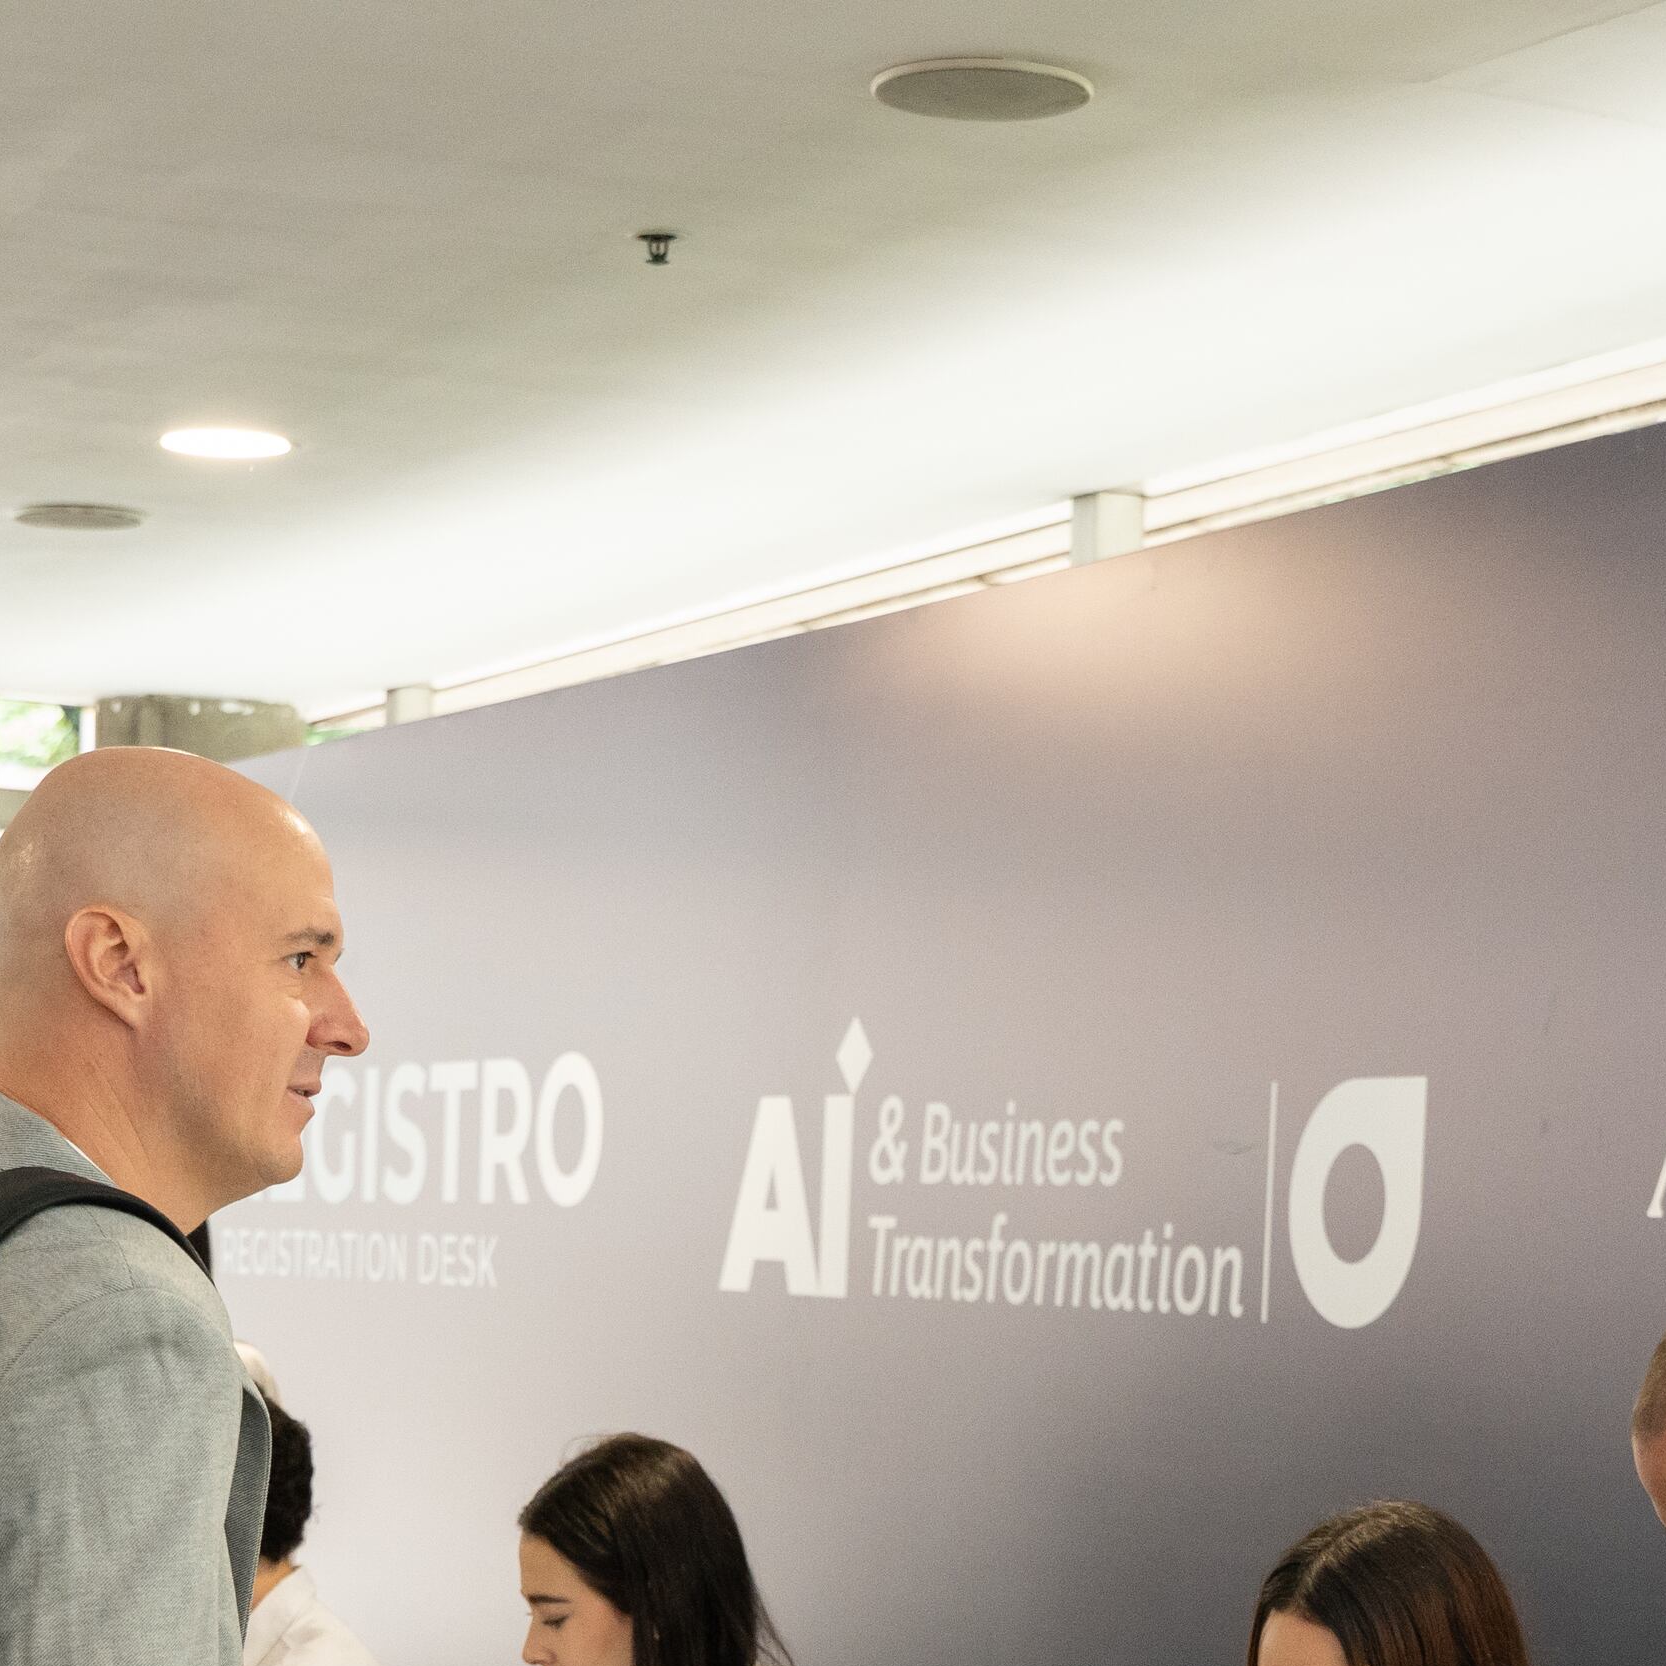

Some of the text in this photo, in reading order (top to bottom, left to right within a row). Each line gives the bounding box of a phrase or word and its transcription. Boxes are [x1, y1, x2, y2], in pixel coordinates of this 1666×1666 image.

[251, 1051, 604, 1208] GISTRO
[869, 1094, 1124, 1187] & Business
[219, 1228, 499, 1288] REGISTRATION DESK
[868, 1212, 1245, 1318] Transformation
